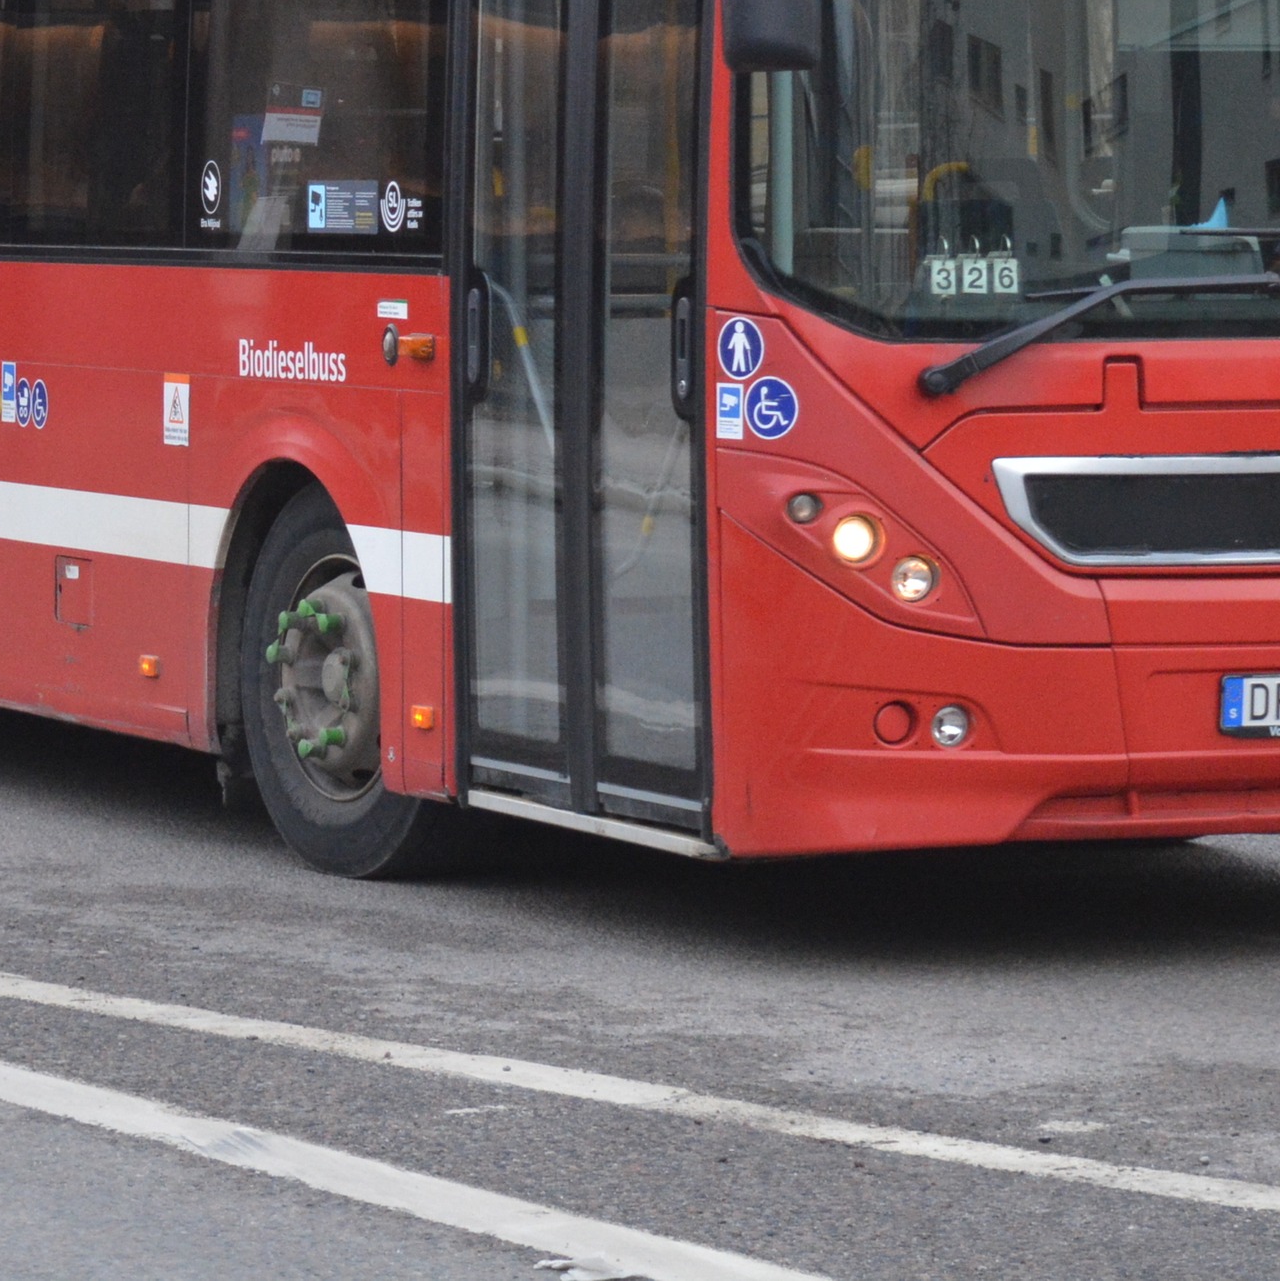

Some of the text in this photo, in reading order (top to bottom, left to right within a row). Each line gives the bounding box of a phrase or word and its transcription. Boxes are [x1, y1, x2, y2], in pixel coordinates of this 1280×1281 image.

[388, 191, 398, 207] SL
[239, 338, 346, 382] Biodieselbuss
[1229, 708, 1238, 718] S
